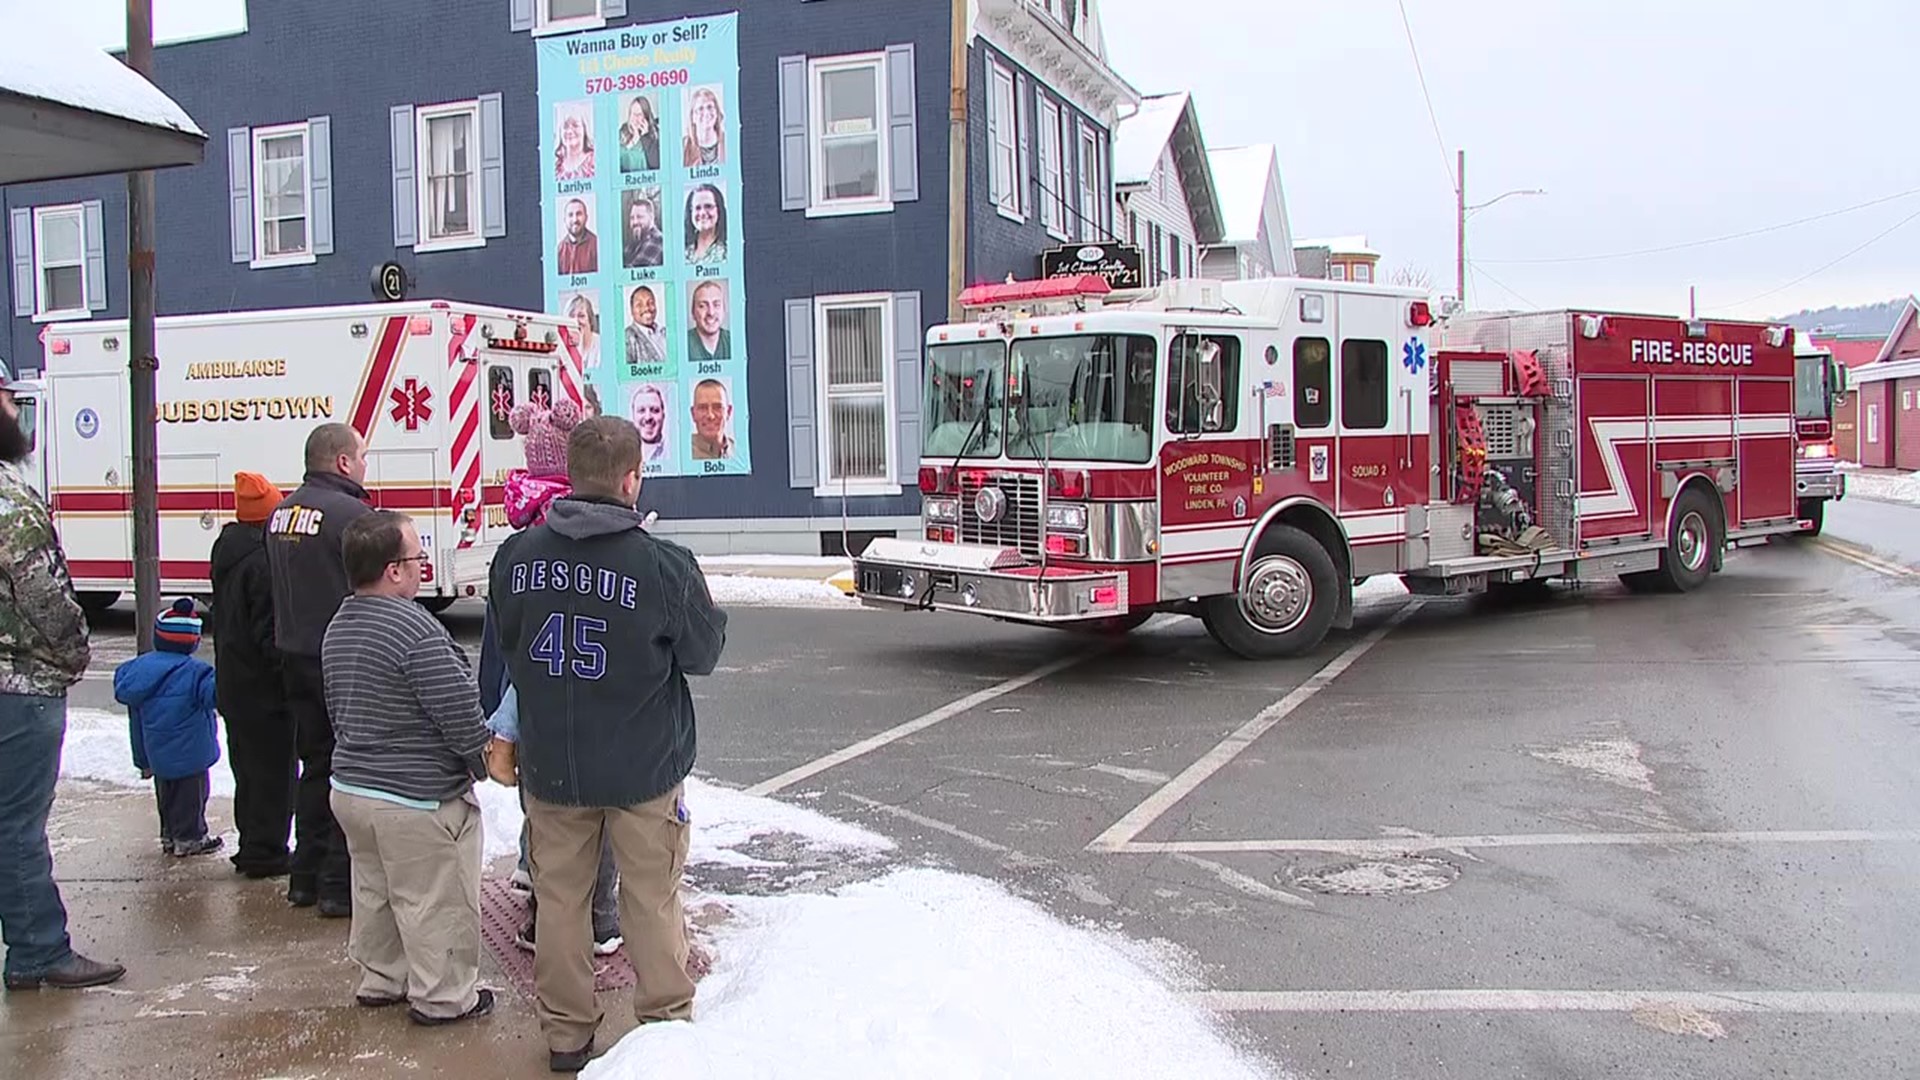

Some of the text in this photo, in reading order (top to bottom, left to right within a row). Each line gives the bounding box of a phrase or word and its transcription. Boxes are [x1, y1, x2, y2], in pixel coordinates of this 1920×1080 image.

[567, 23, 708, 55] Wanna Buy or Sell?
[603, 53, 650, 70] Choice
[654, 47, 697, 64] Realty
[585, 68, 688, 94] 570-398-0690
[625, 173, 656, 185] Rachel
[690, 166, 719, 179] Linda
[1083, 249, 1099, 258] 301
[695, 266, 719, 277] Pam
[1071, 260, 1097, 272] Choice
[1098, 258, 1125, 276] Realty
[570, 275, 587, 287] Jon
[631, 269, 655, 281] Luke
[1122, 269, 1138, 283] 21
[1632, 339, 1752, 365] FIRE-RESCUE
[185, 358, 287, 380] AMBULANCE
[631, 365, 662, 377] Booker
[698, 363, 721, 375] Josh
[704, 462, 725, 473] Bob
[1164, 453, 1247, 476] WOODWARD TOWNSHIP
[1352, 464, 1387, 477] SQUAD 2
[1183, 471, 1229, 482] VOLUNTEER
[1189, 484, 1207, 495] FIRE
[512, 560, 637, 609] RESCUE
[528, 612, 607, 680] 45
